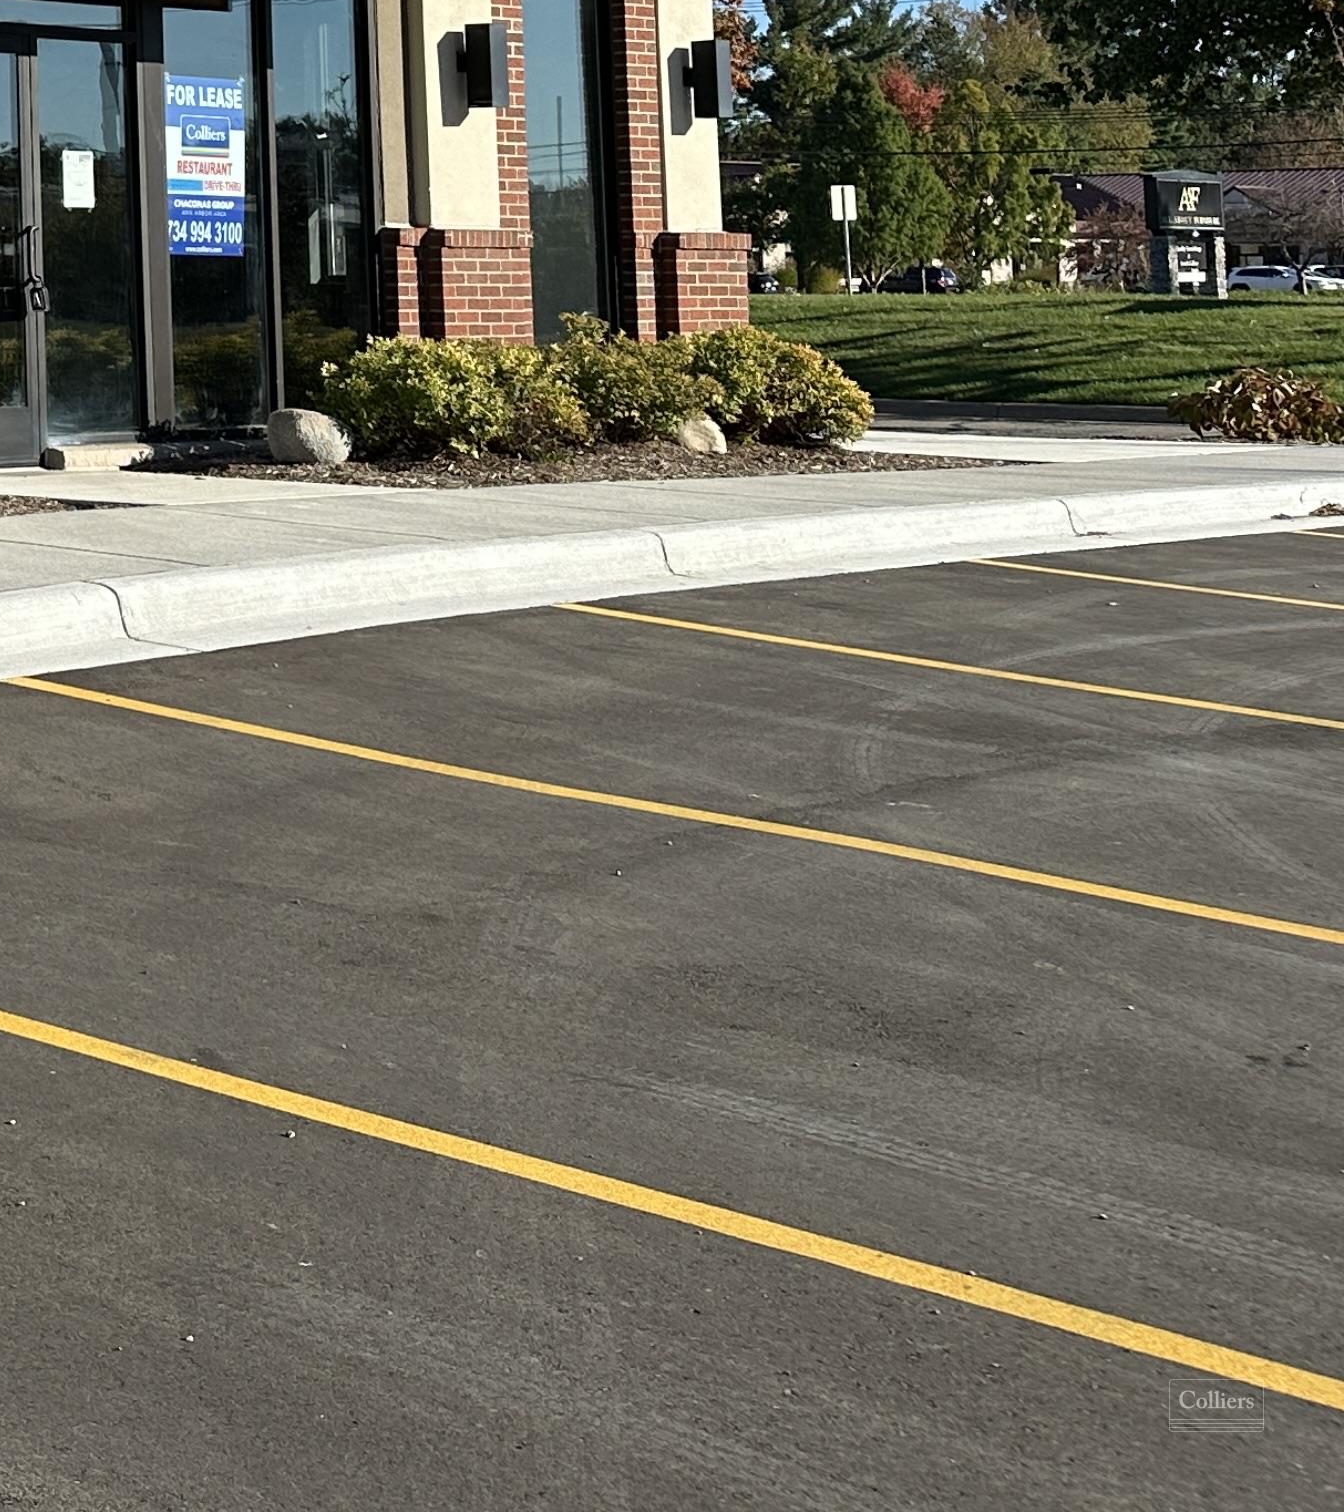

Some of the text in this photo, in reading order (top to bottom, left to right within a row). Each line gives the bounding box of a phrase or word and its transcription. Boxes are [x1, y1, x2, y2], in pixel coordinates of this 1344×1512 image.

[166, 83, 243, 109] FOR LEASE
[185, 123, 226, 142] Colliers
[176, 159, 233, 176] RESTAURANT
[212, 199, 235, 210] GROUP
[167, 219, 243, 245] 734 994 3100
